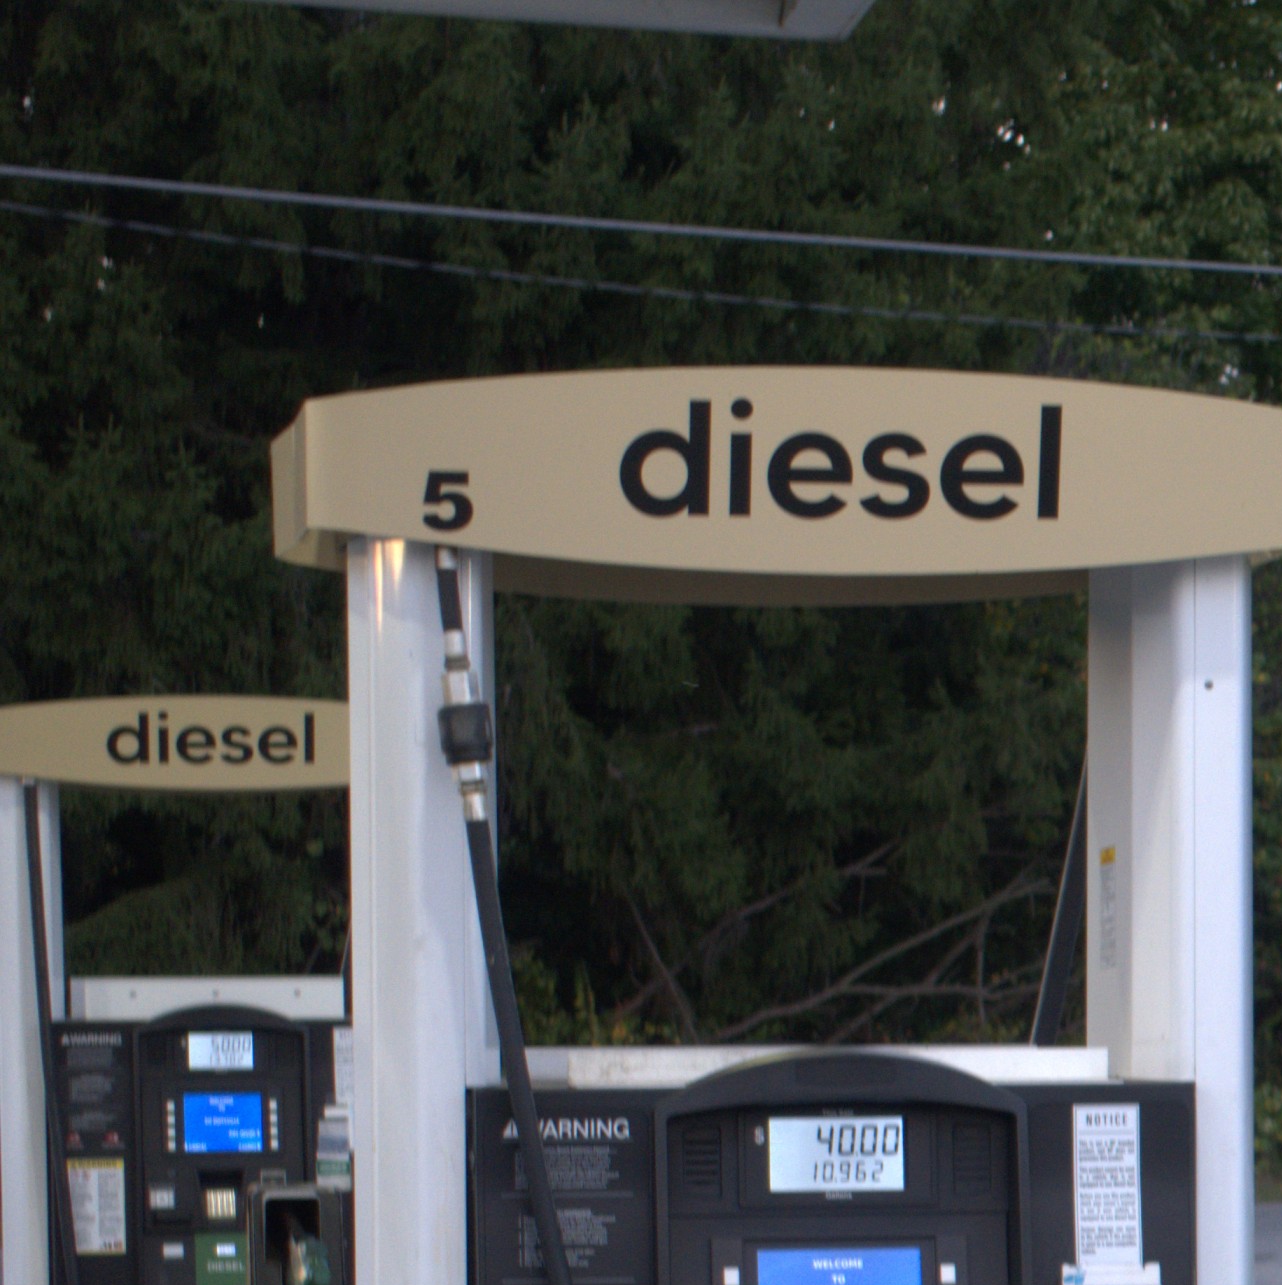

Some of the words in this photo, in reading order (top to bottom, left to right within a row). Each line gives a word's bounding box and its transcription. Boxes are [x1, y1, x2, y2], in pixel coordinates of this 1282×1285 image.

[422, 470, 474, 532] 5
[619, 397, 1063, 521] diesel
[106, 711, 315, 765] diesel
[1086, 1112, 1127, 1127] NOTICE
[813, 1258, 863, 1270] WELCOME
[832, 1274, 846, 1285] TO
